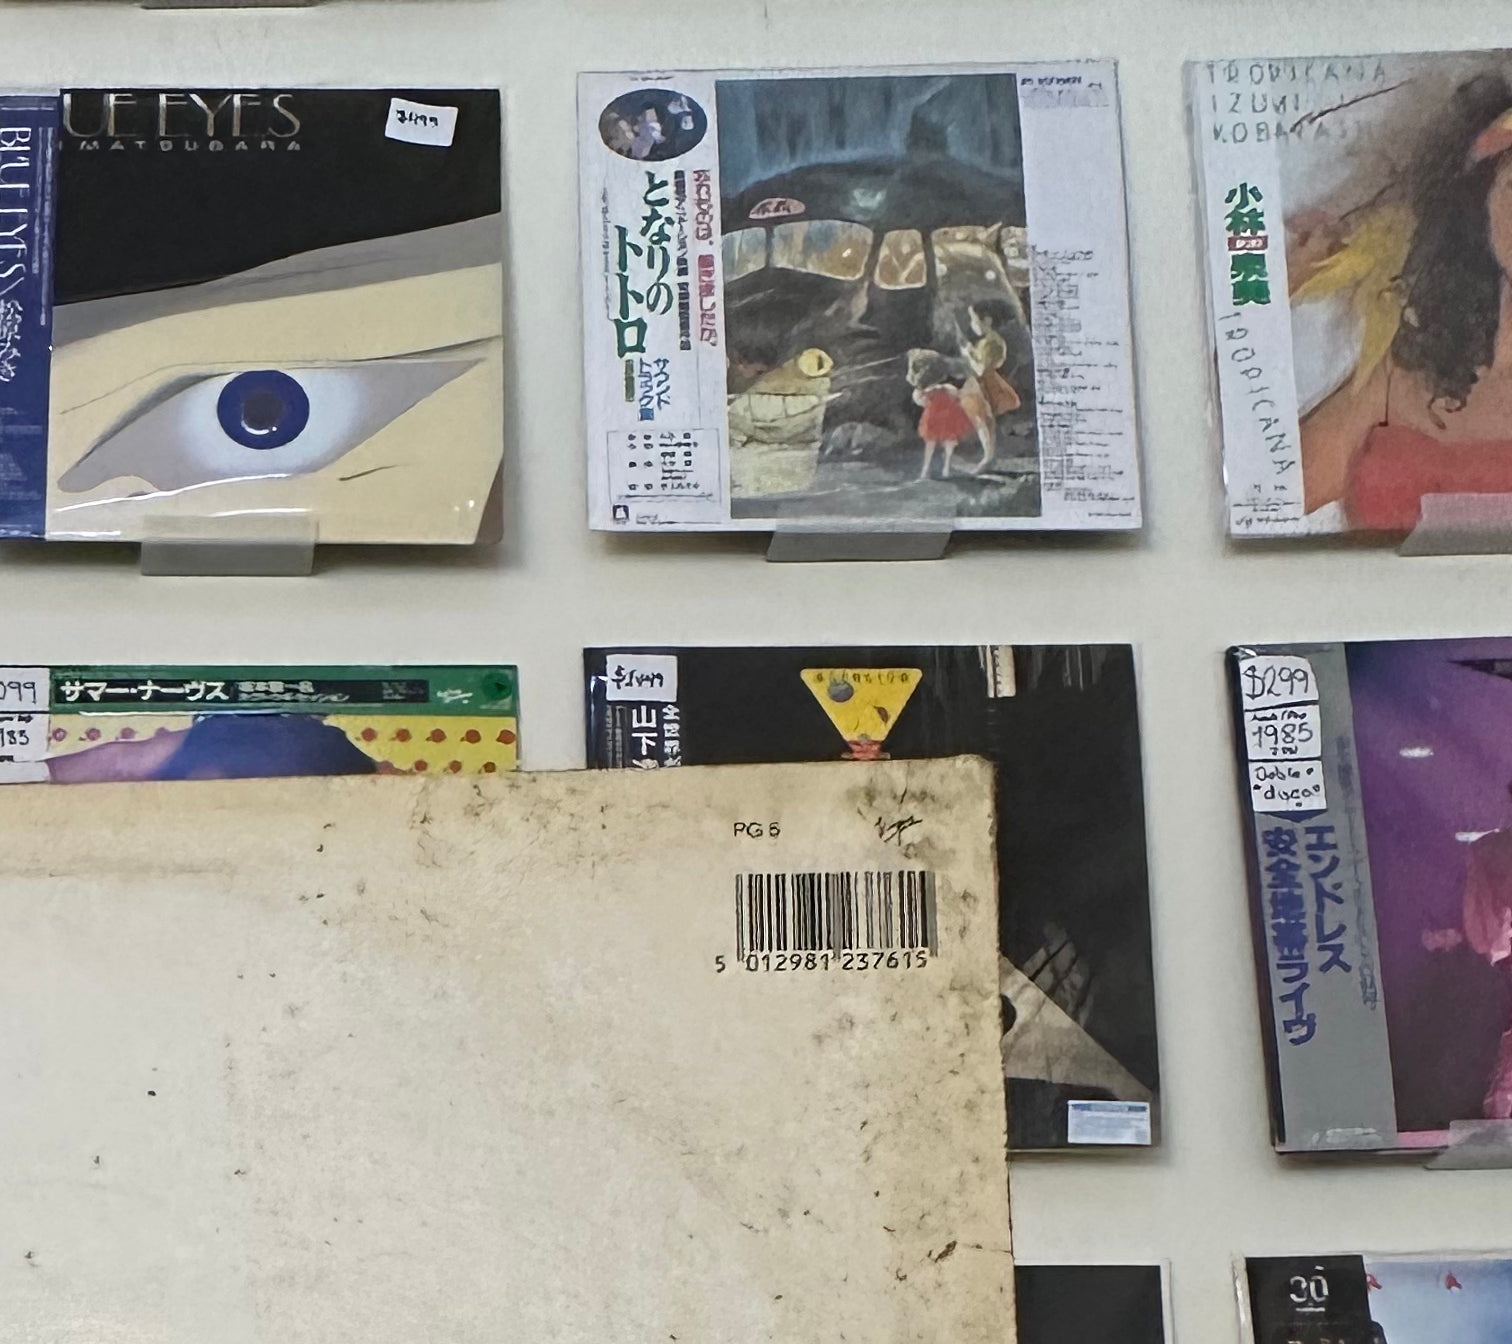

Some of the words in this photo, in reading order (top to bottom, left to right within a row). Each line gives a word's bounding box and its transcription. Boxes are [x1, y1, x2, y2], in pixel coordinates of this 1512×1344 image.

[63, 93, 137, 138] UE
[159, 93, 301, 138] EYES
[640, 171, 675, 316] となりの
[614, 224, 648, 358] トトロ
[1243, 665, 1310, 699] $299
[1253, 722, 1314, 749] 1985
[734, 821, 764, 839] PG
[1304, 825, 1352, 974] エンドレス
[715, 955, 726, 973] 5
[746, 953, 830, 972] 012981
[842, 950, 928, 970] 237615
